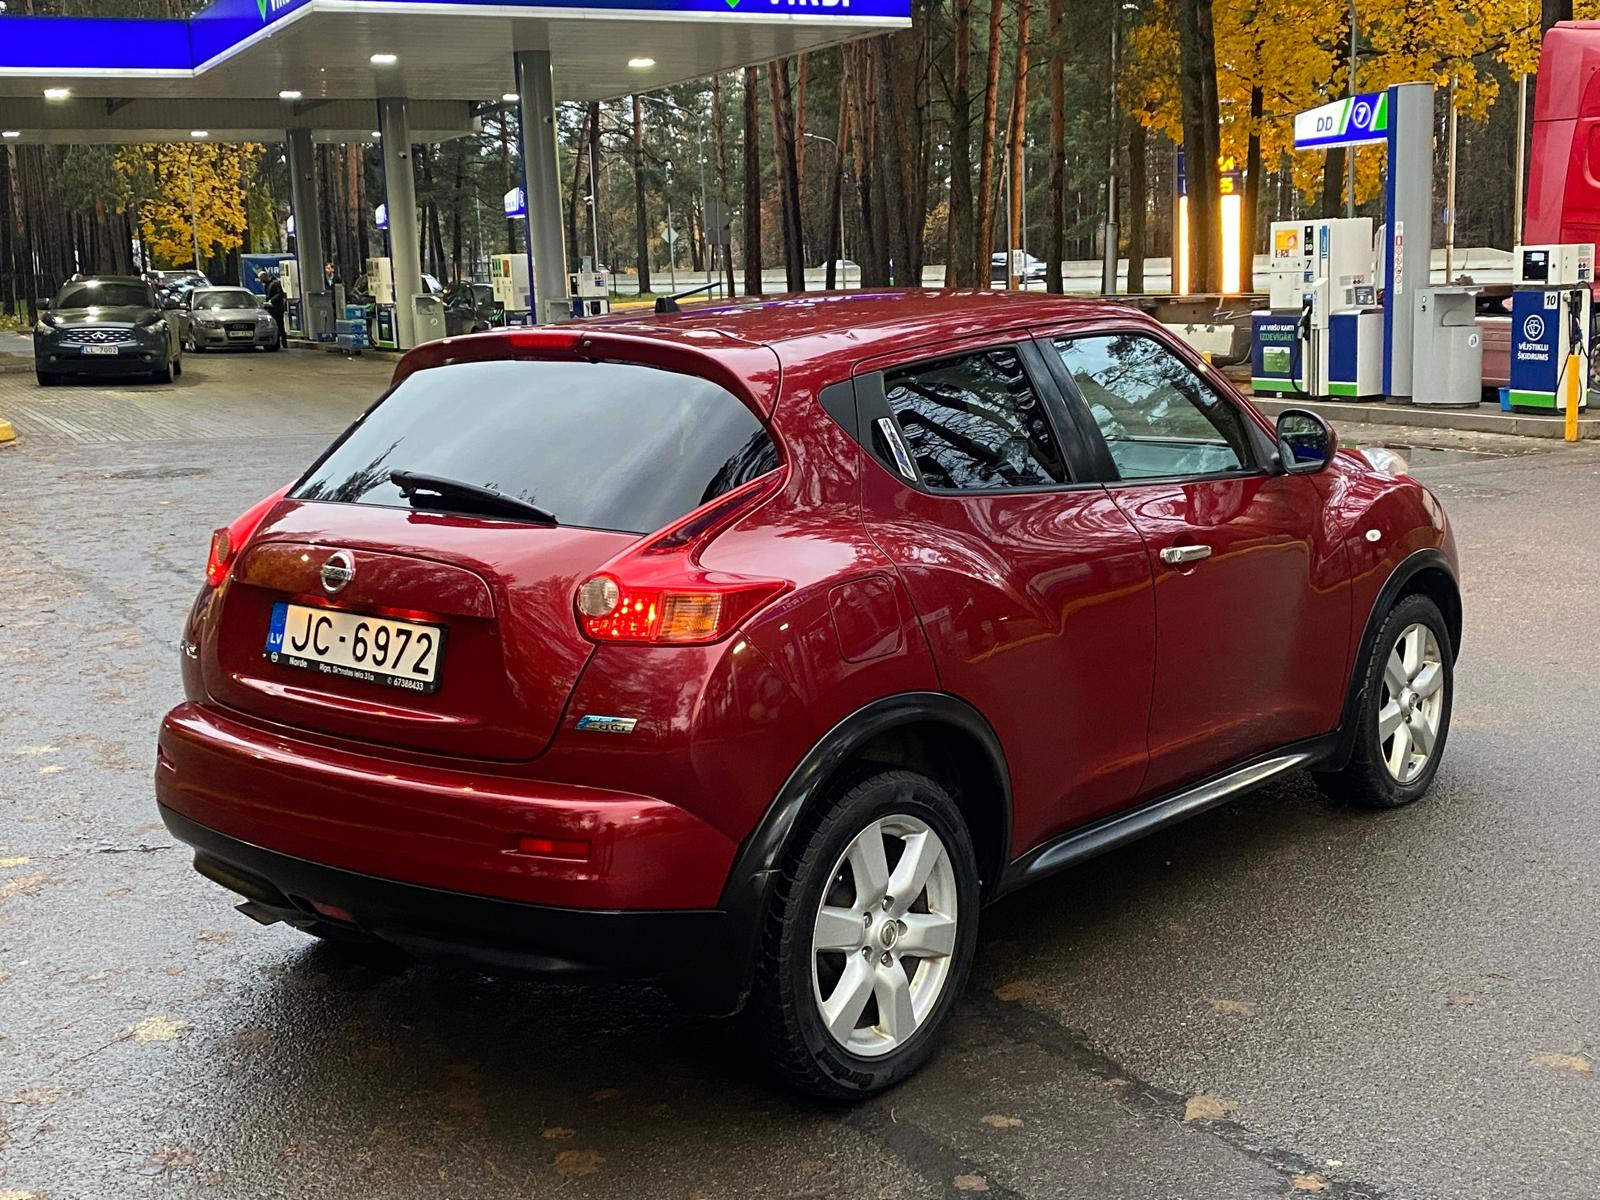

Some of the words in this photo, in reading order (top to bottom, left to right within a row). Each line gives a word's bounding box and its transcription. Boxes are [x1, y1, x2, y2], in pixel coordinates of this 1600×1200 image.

[1316, 117, 1333, 132] DD
[1305, 260, 1312, 269] 7
[1545, 295, 1556, 306] 10
[270, 632, 283, 645] LV
[291, 613, 434, 676] JC-6972
[289, 656, 308, 668] Norde
[393, 677, 424, 691] 67388433
